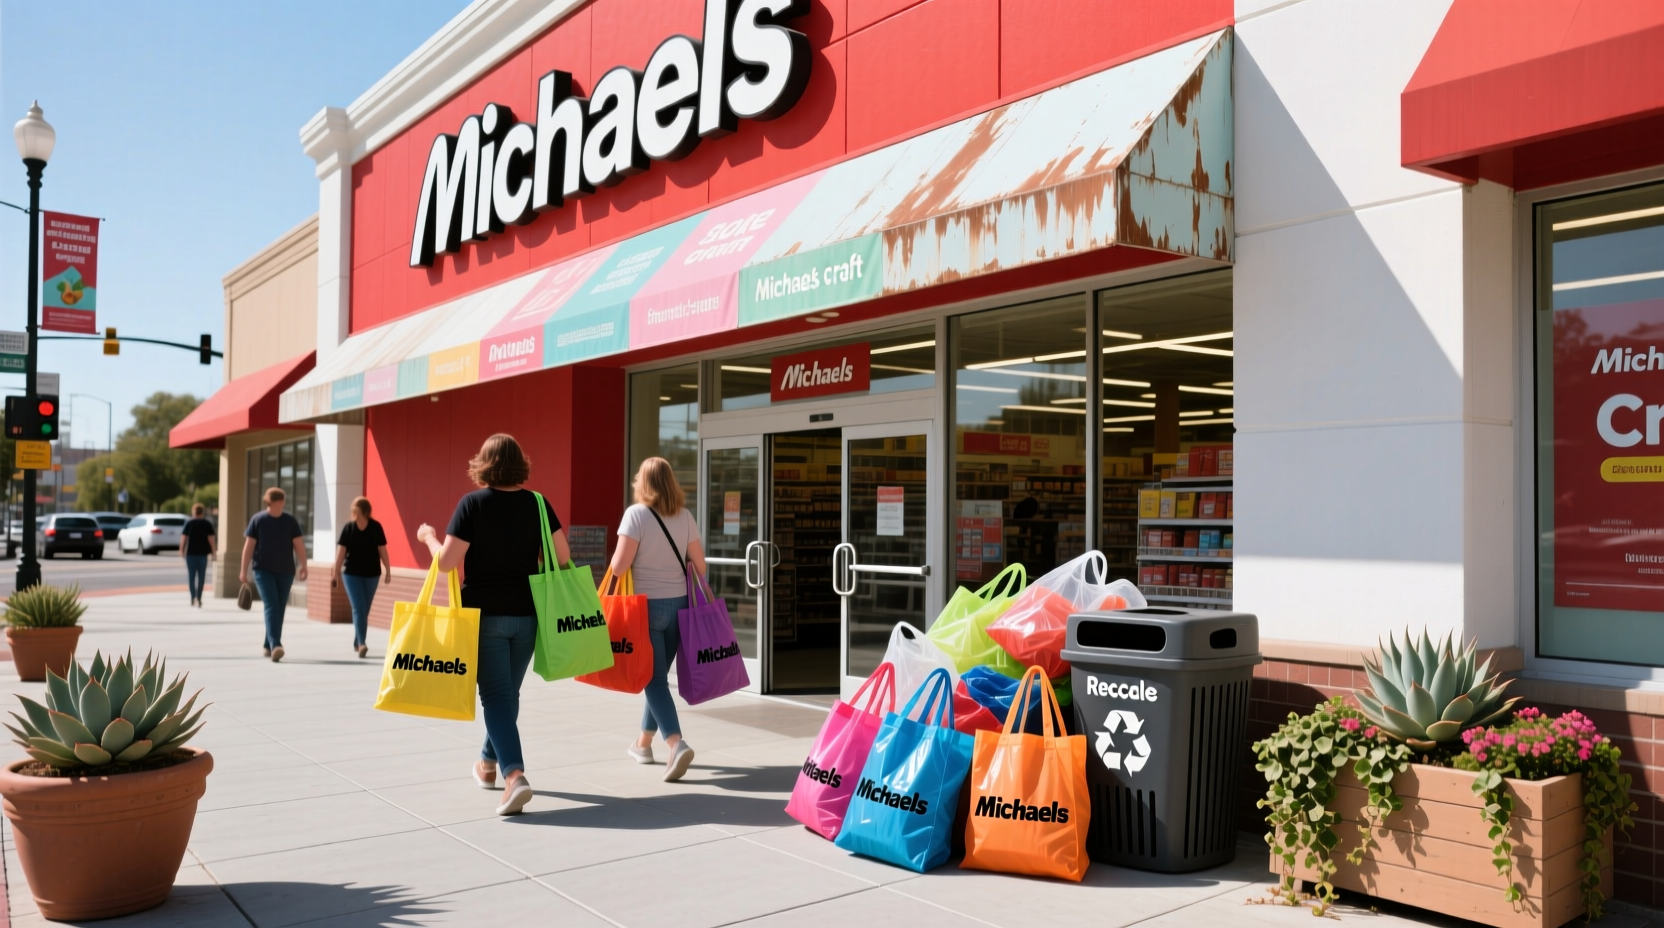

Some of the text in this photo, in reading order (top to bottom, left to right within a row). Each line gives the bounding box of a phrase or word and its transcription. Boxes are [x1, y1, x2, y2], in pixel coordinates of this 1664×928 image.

[410, 0, 798, 267] Michaels
[823, 253, 864, 286] craft
[780, 356, 854, 391] Michaels
[1086, 675, 1159, 702] Reccale
[974, 796, 1070, 824] Michaels
